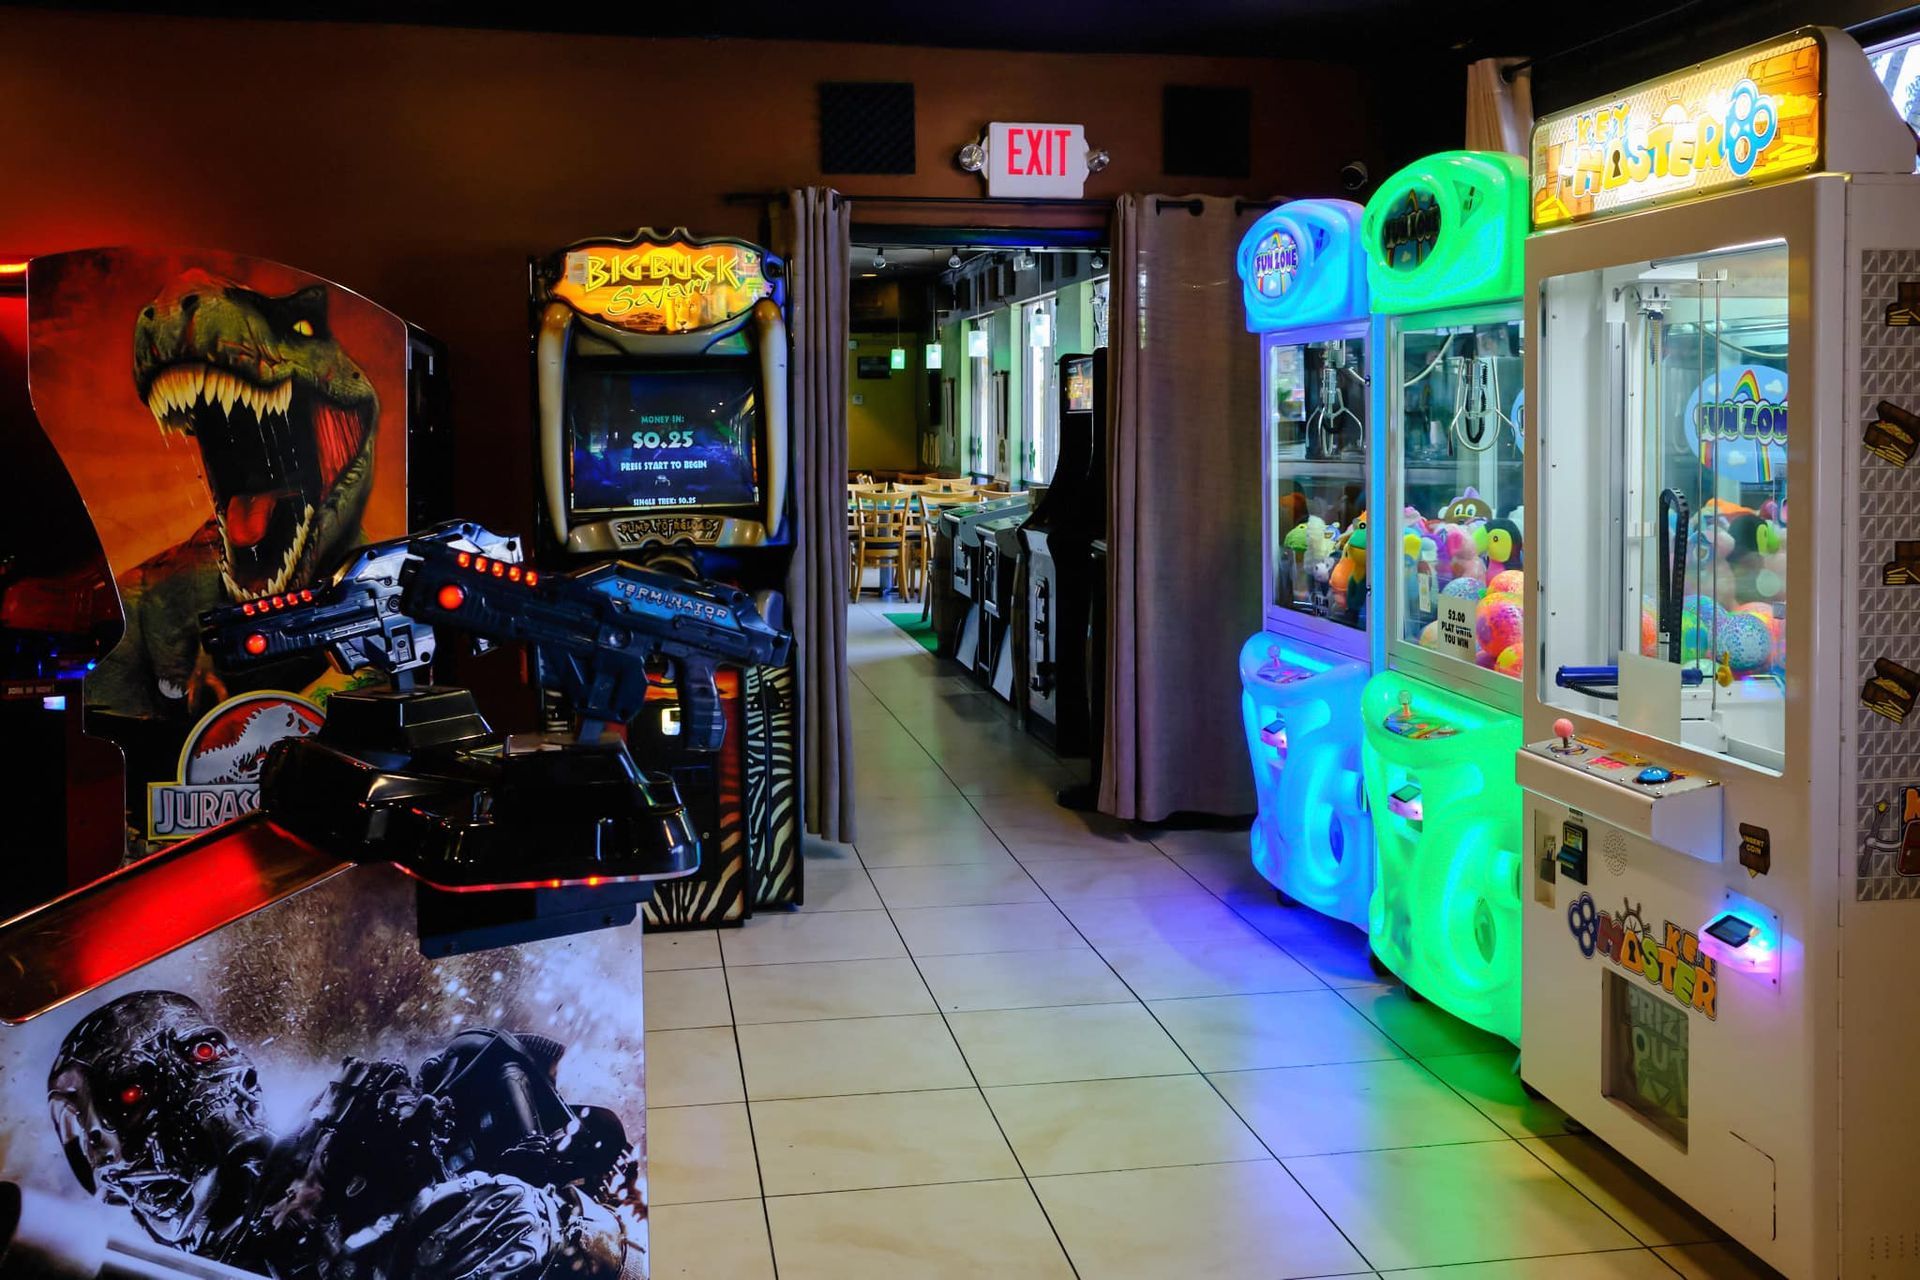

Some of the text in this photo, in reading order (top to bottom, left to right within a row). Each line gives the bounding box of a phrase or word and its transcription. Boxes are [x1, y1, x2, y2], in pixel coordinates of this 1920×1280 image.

[1576, 102, 1631, 146] KEY
[1008, 128, 1071, 176] EXIT
[1572, 115, 1724, 198] MASTER
[586, 254, 742, 292] BIG BUCK
[1256, 247, 1297, 271] FUN ZONE
[607, 276, 714, 315] Safari
[641, 415, 685, 424] MONEY IN:
[1699, 403, 1788, 439] FUN ZON
[632, 431, 694, 449] $0.25
[620, 460, 707, 471] PRESS START TO BEGIN
[617, 581, 728, 618] TERMINATOR
[1441, 621, 1455, 632] PLAY
[1444, 633, 1456, 644] YOU
[155, 787, 261, 834] JURAS
[1597, 911, 1716, 1020] MASTER
[1665, 922, 1715, 974] KE
